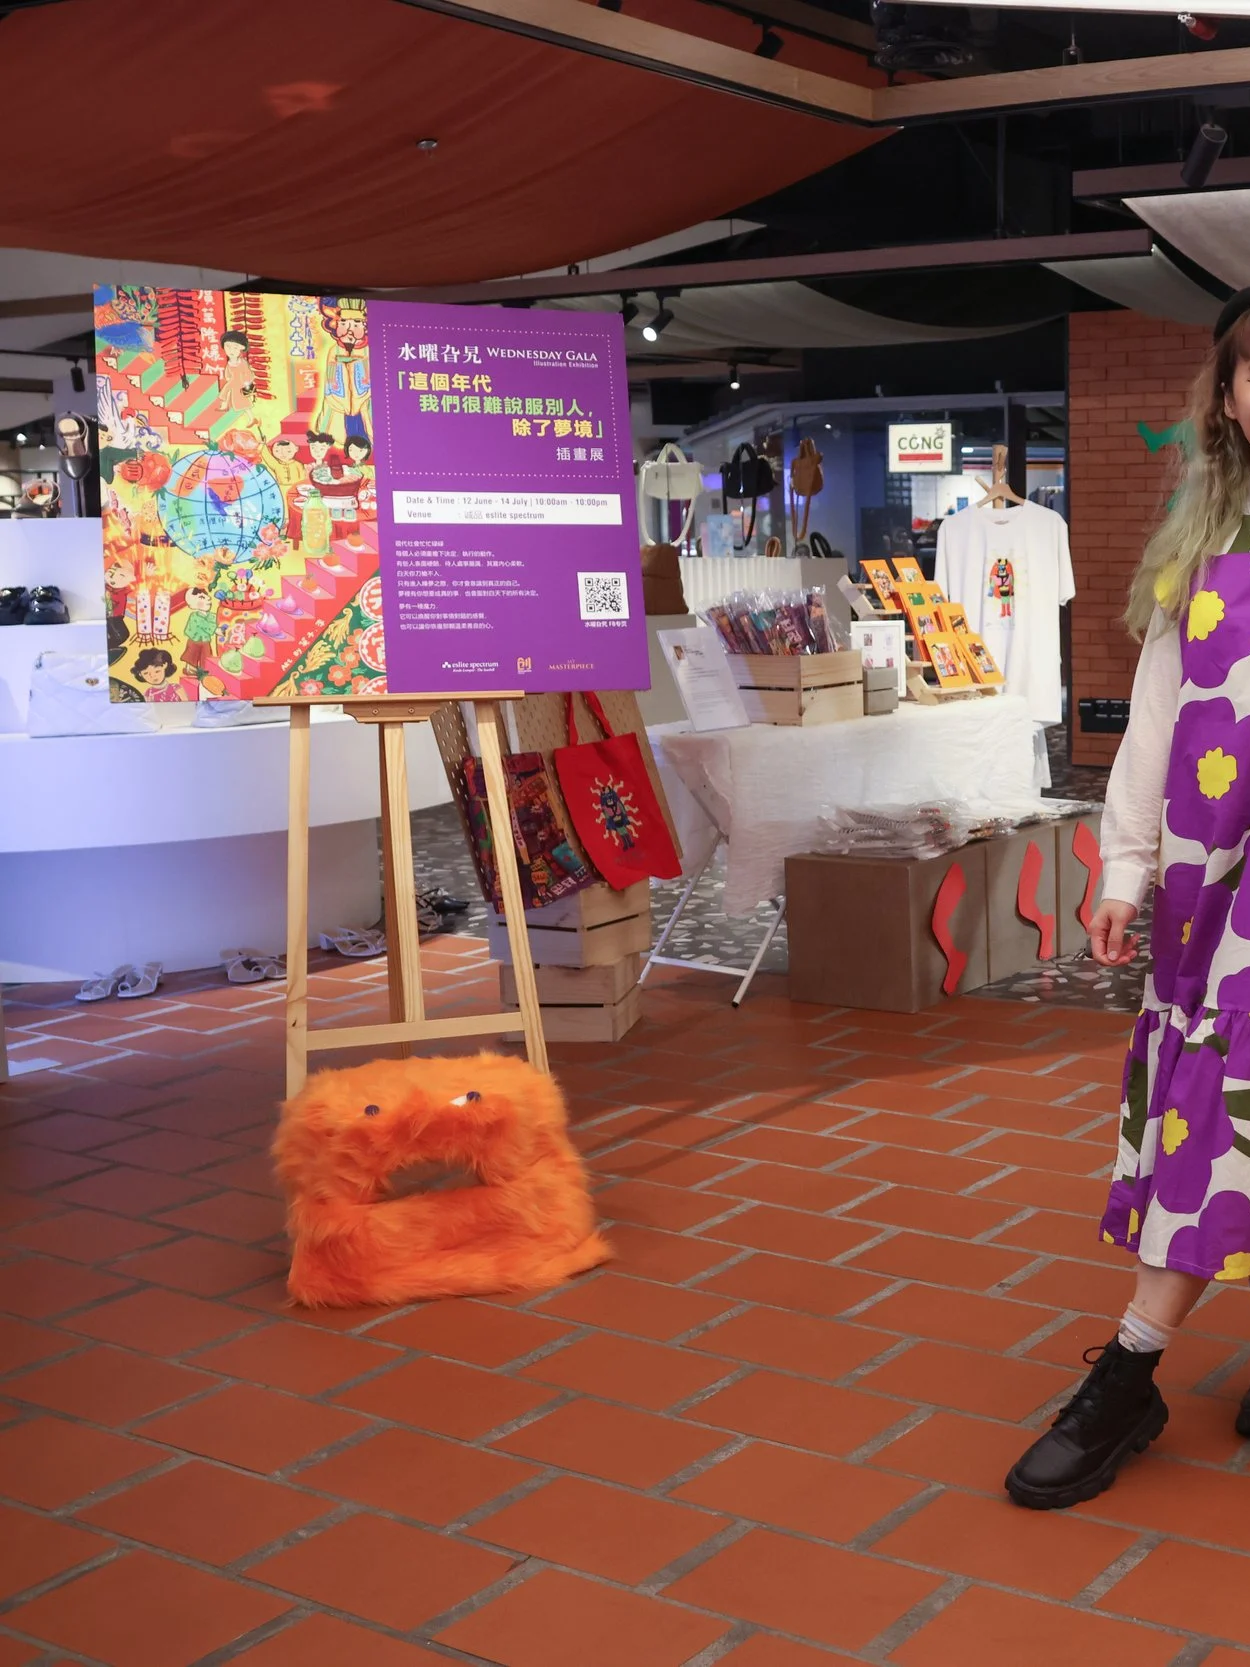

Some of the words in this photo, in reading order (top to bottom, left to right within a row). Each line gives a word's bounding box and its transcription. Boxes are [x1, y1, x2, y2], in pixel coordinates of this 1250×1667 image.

[486, 347, 563, 361] WEDNESDAY
[565, 350, 598, 362] GALA
[533, 360, 568, 368] Illustration
[568, 361, 599, 369] Exhibition
[397, 371, 493, 393] 「這個年代
[512, 418, 604, 439] 除了夢境」
[406, 496, 424, 504] Date
[426, 496, 433, 504] &
[436, 496, 455, 505] Time
[463, 497, 472, 505] 12
[474, 497, 493, 505] June
[501, 497, 510, 505] 14
[512, 497, 528, 507] July
[576, 499, 608, 508] 10:00pm
[407, 510, 432, 518] Venue
[485, 511, 507, 519] eslite
[509, 512, 545, 521] spectrum
[549, 663, 595, 671] MASTERPIECE
